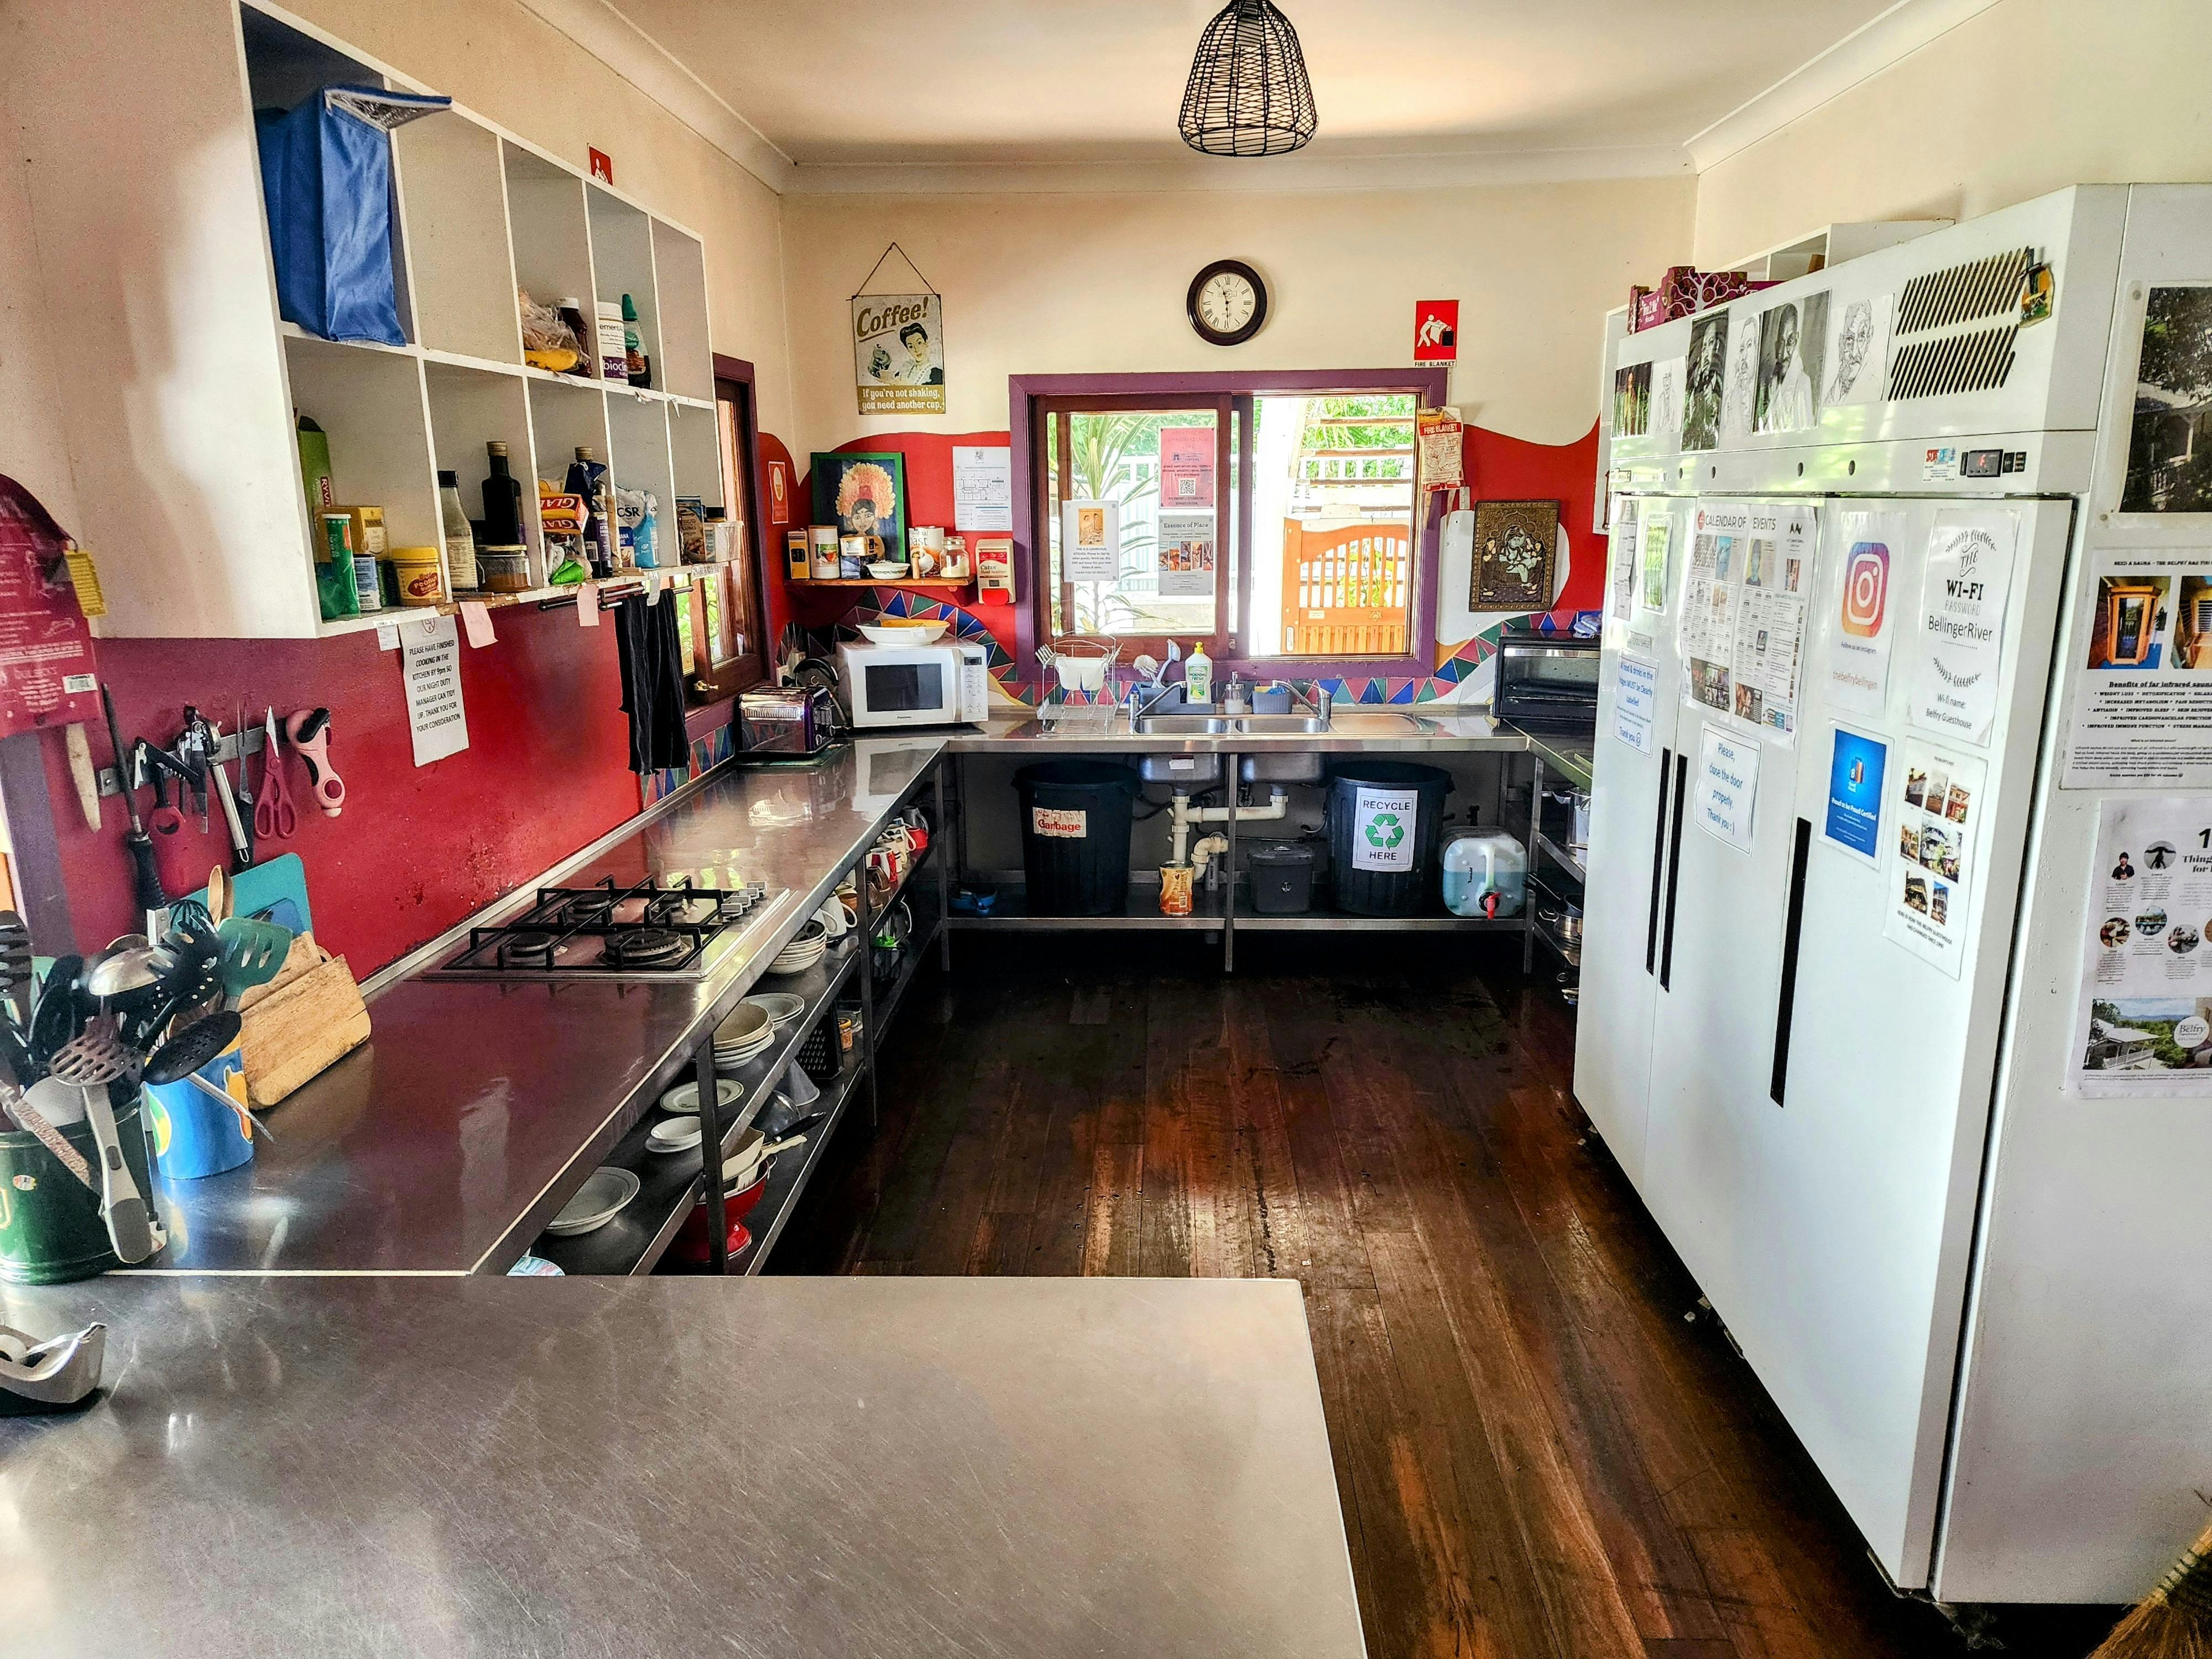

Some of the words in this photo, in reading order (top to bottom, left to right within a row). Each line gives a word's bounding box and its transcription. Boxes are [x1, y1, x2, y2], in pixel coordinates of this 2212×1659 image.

[857, 296, 929, 337] Coffee!
[863, 388, 870, 398] If
[869, 389, 894, 400] you're
[895, 389, 907, 398] not
[862, 402, 876, 411] you
[877, 400, 896, 410] need
[896, 400, 926, 410] another
[926, 401, 942, 412] cup.
[1423, 426, 1435, 435] FIRE
[1436, 423, 1458, 434] BLANKET
[617, 507, 641, 518] CSR
[1705, 514, 1736, 527] CALENDAR
[1738, 516, 1747, 528] OF
[1752, 517, 1777, 531] EVENTS
[1960, 550, 1979, 569] THE
[1947, 579, 1984, 601] WI-FI
[1944, 599, 1981, 616] PASSWORD
[1928, 615, 1993, 642] BellingerRiver
[409, 646, 425, 656] PLEASE
[425, 644, 437, 653] HAVE
[436, 639, 455, 650] FINISHED
[416, 656, 435, 667] COOKING
[412, 670, 430, 681] KITCHEN
[416, 683, 426, 693] OUR
[427, 680, 440, 691] NIGHT
[440, 677, 451, 687] DUTY
[1627, 679, 1636, 690] MUST
[416, 696, 437, 707] MANAGER
[447, 688, 456, 698] TIDY
[1938, 692, 1950, 704] Wi-fi
[1950, 698, 1967, 709] name:
[417, 711, 425, 719] UP.
[425, 707, 440, 718] THANK
[448, 701, 457, 709] FOR
[1926, 708, 1942, 722] Belfry
[1942, 712, 1973, 729] Guesthouse
[416, 723, 429, 733] YOUR
[429, 712, 461, 729] CONSIDERATION
[1718, 742, 1735, 763] Please,
[1709, 762, 1721, 779] close
[1730, 774, 1744, 789] door
[1363, 800, 1411, 811] RECYCLE
[1037, 819, 1081, 833] Garbage
[1707, 807, 1721, 825] Thank
[1721, 817, 1729, 830] you
[1369, 852, 1397, 860] HERE
[2183, 855, 2212, 864] Thing
[2192, 865, 2209, 873] for
[2179, 1024, 2206, 1035] Belfry
